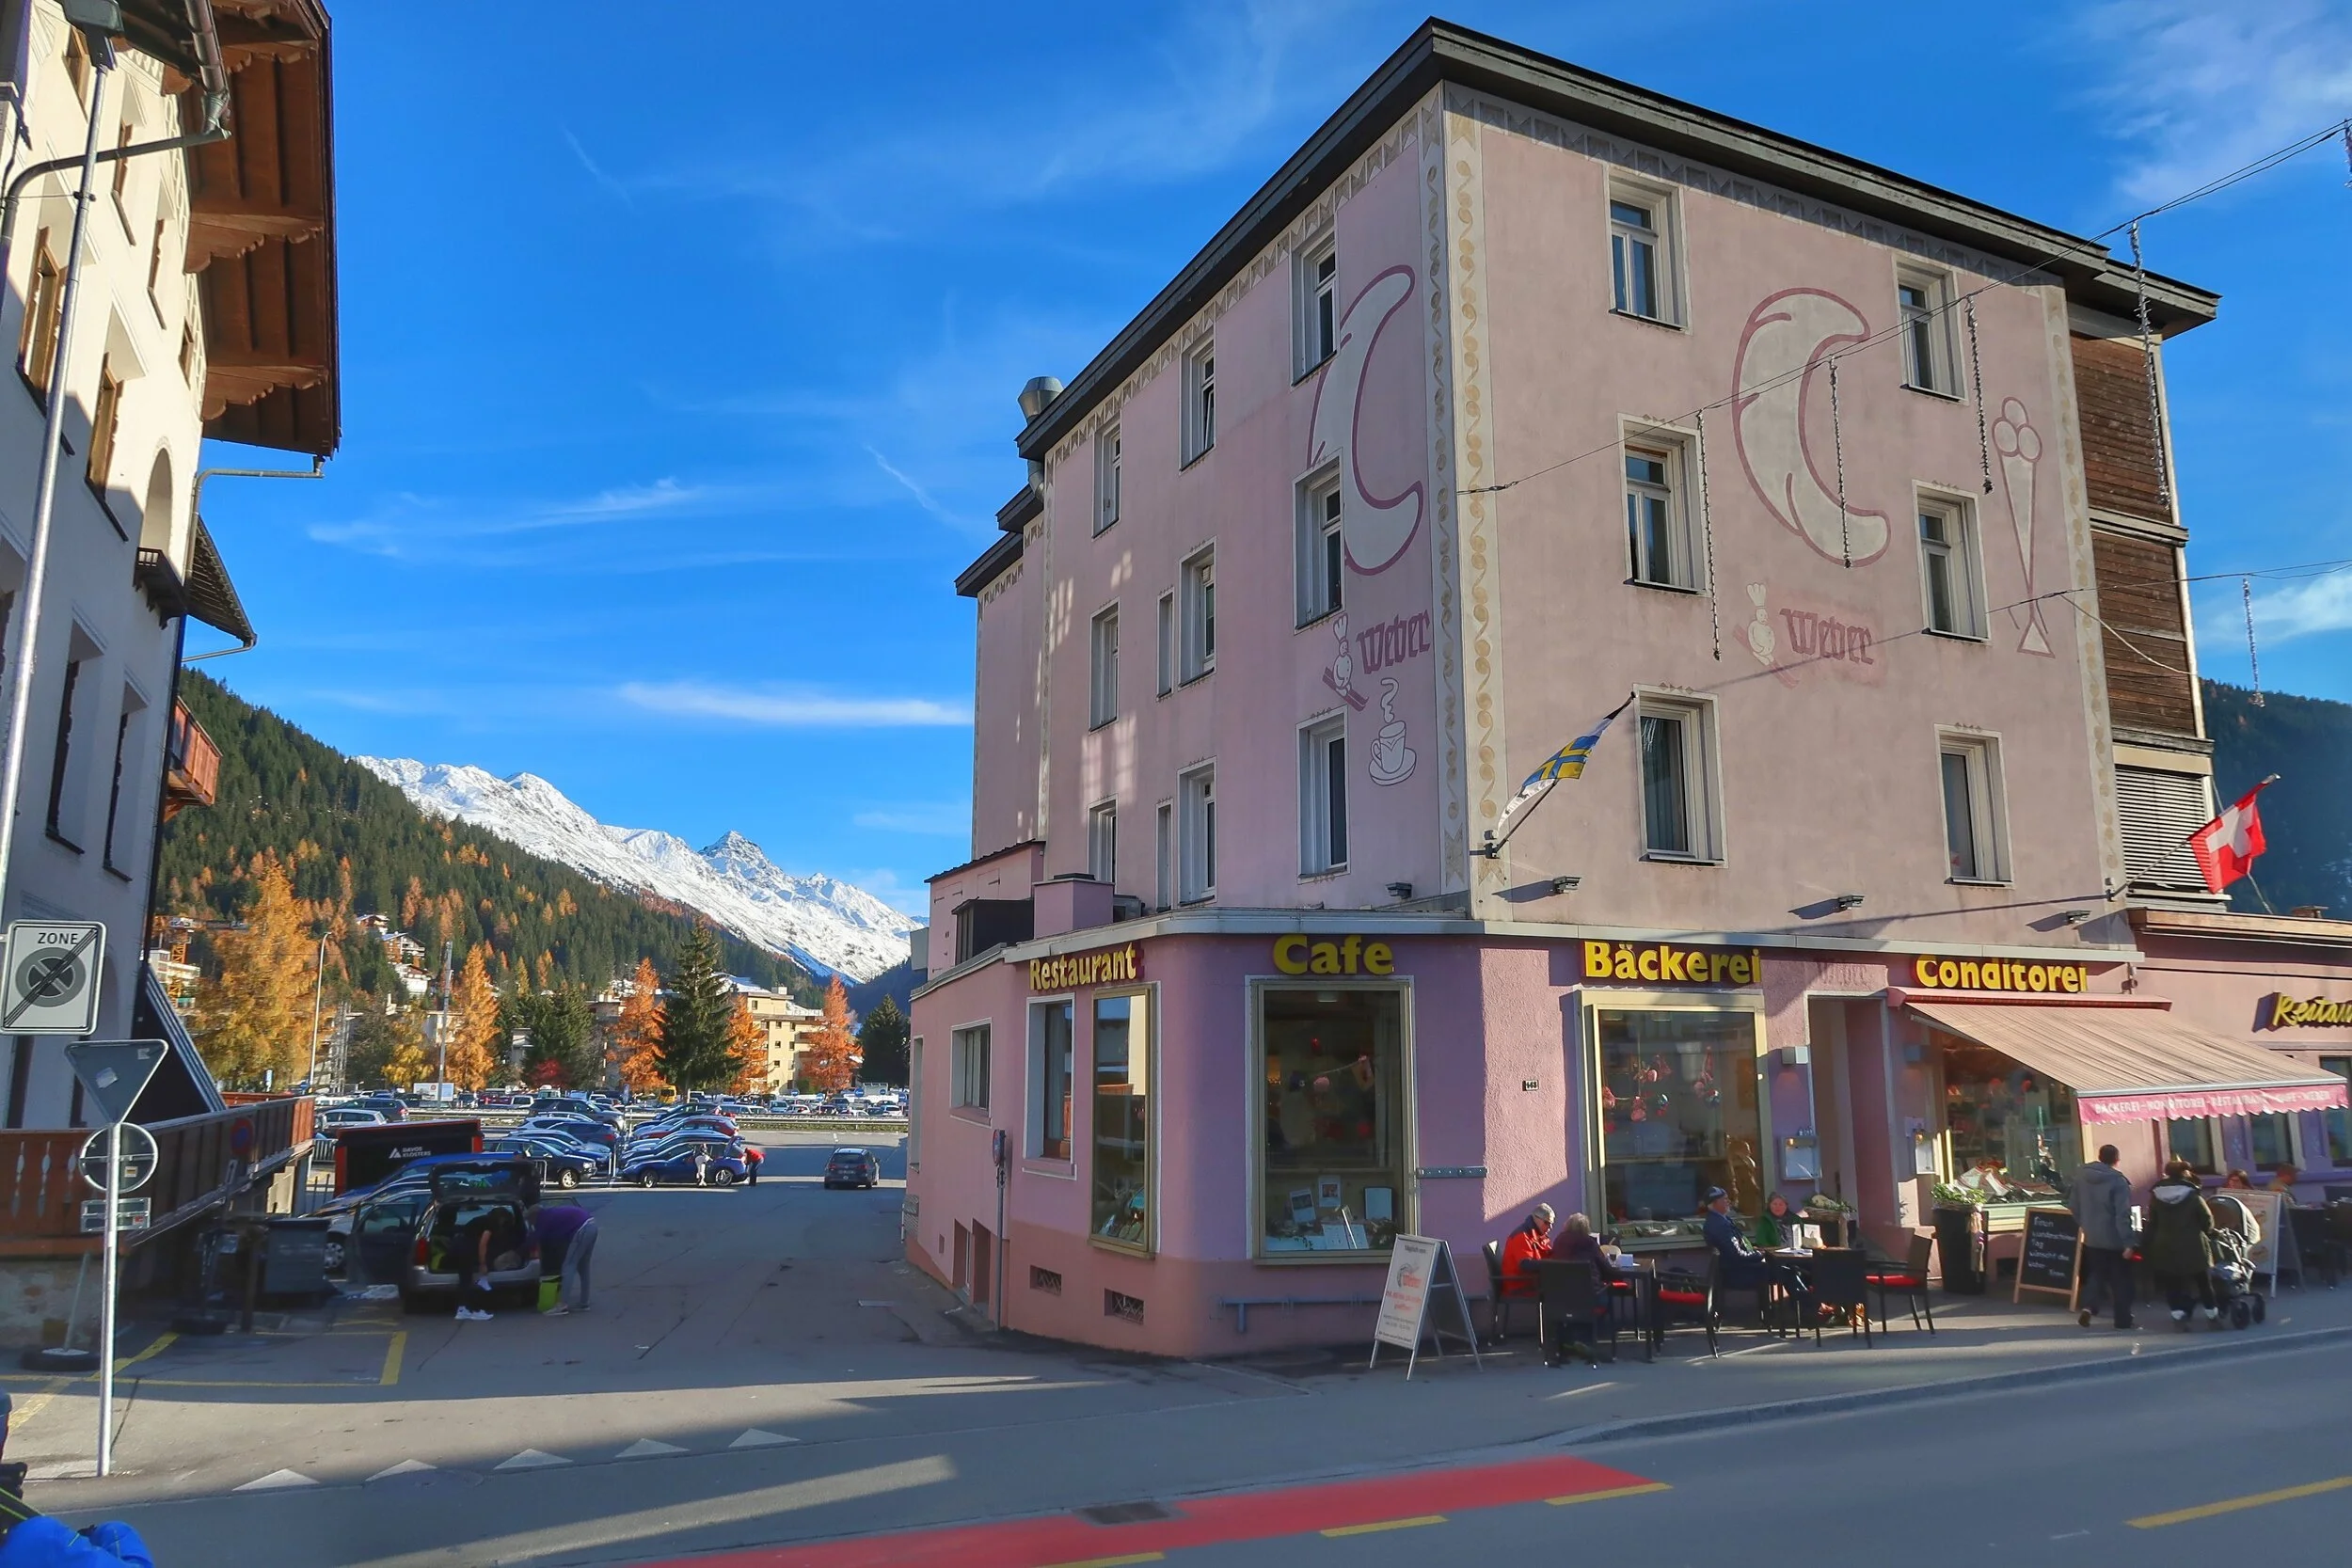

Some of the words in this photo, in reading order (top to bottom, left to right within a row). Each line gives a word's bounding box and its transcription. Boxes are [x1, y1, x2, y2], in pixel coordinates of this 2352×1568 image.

[1356, 610, 1431, 674] Weber
[1779, 608, 1874, 665] Weber
[38, 932, 78, 944] ZONE
[1273, 934, 1393, 974] Cafe
[1029, 942, 1136, 990] Restaurant
[1584, 941, 1761, 984] Bäckerei
[1916, 954, 2088, 992] Conditorei
